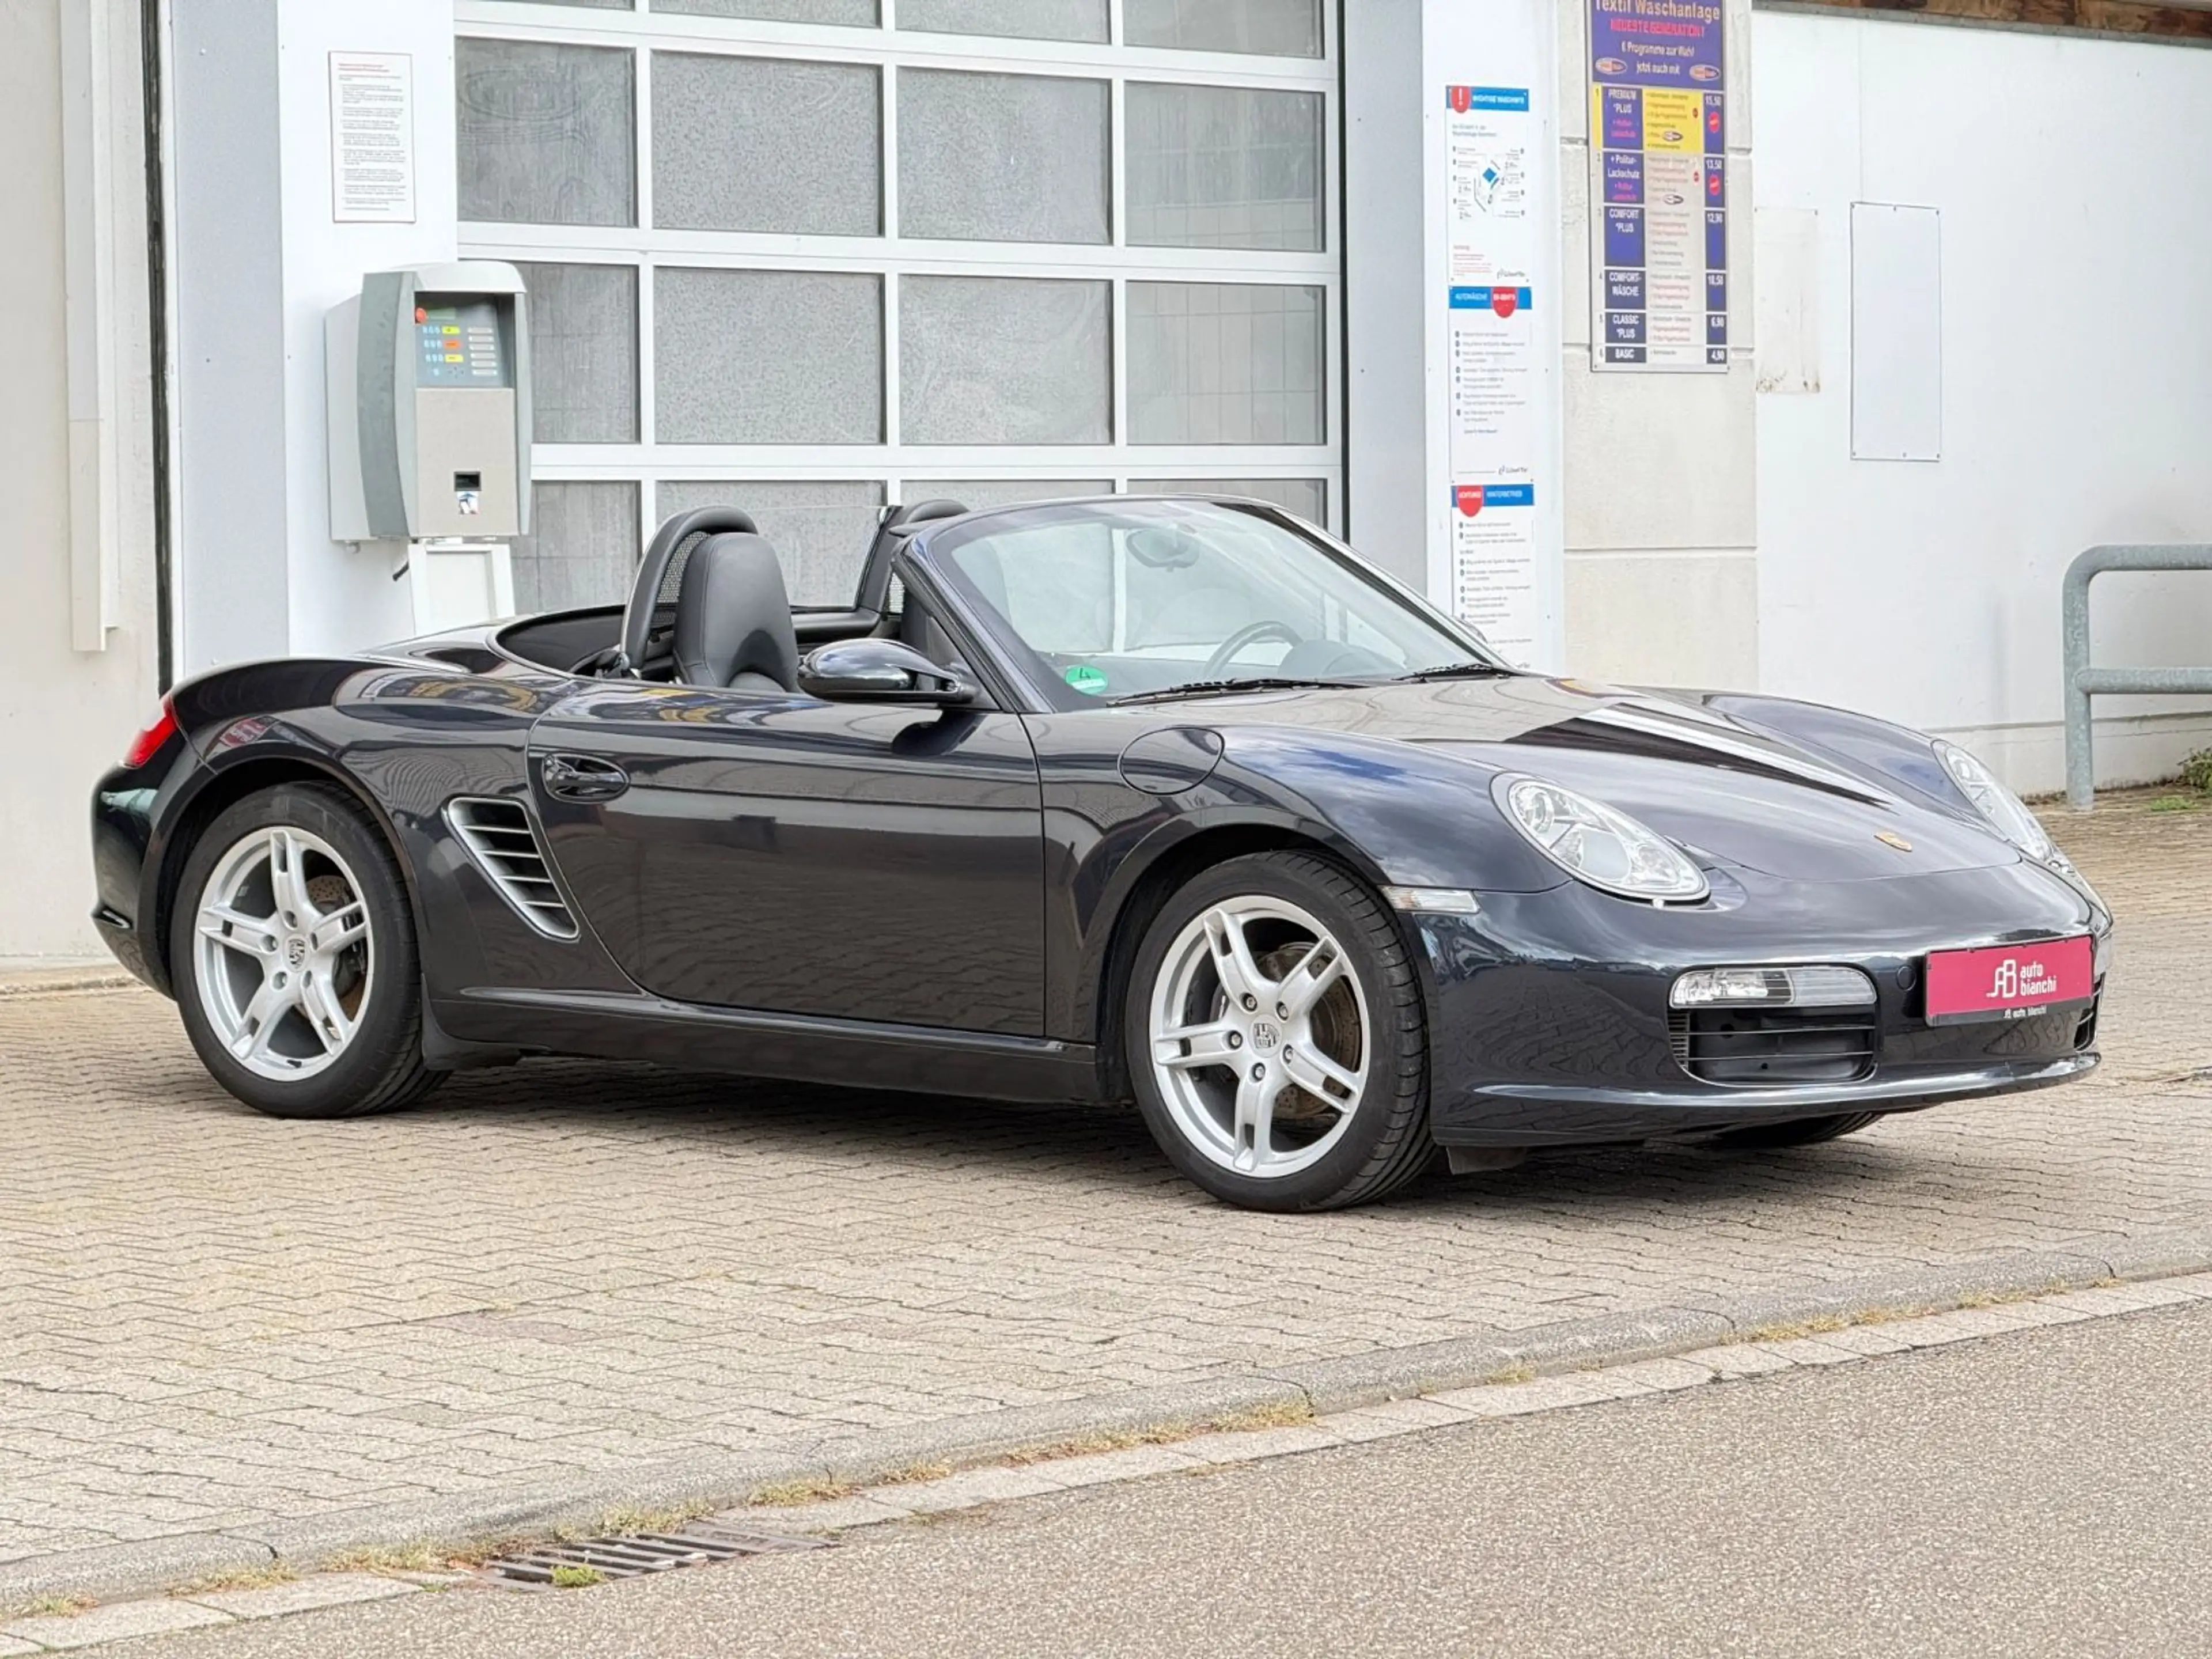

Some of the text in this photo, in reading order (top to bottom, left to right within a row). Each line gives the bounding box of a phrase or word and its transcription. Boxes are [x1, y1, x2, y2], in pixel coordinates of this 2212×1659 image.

[1596, 0, 1721, 24] Textil Waschanlage
[1615, 349, 1635, 359] BASIC
[1080, 667, 1090, 679] 4
[2020, 960, 2044, 978] auto
[2021, 974, 2057, 996] bianchi
